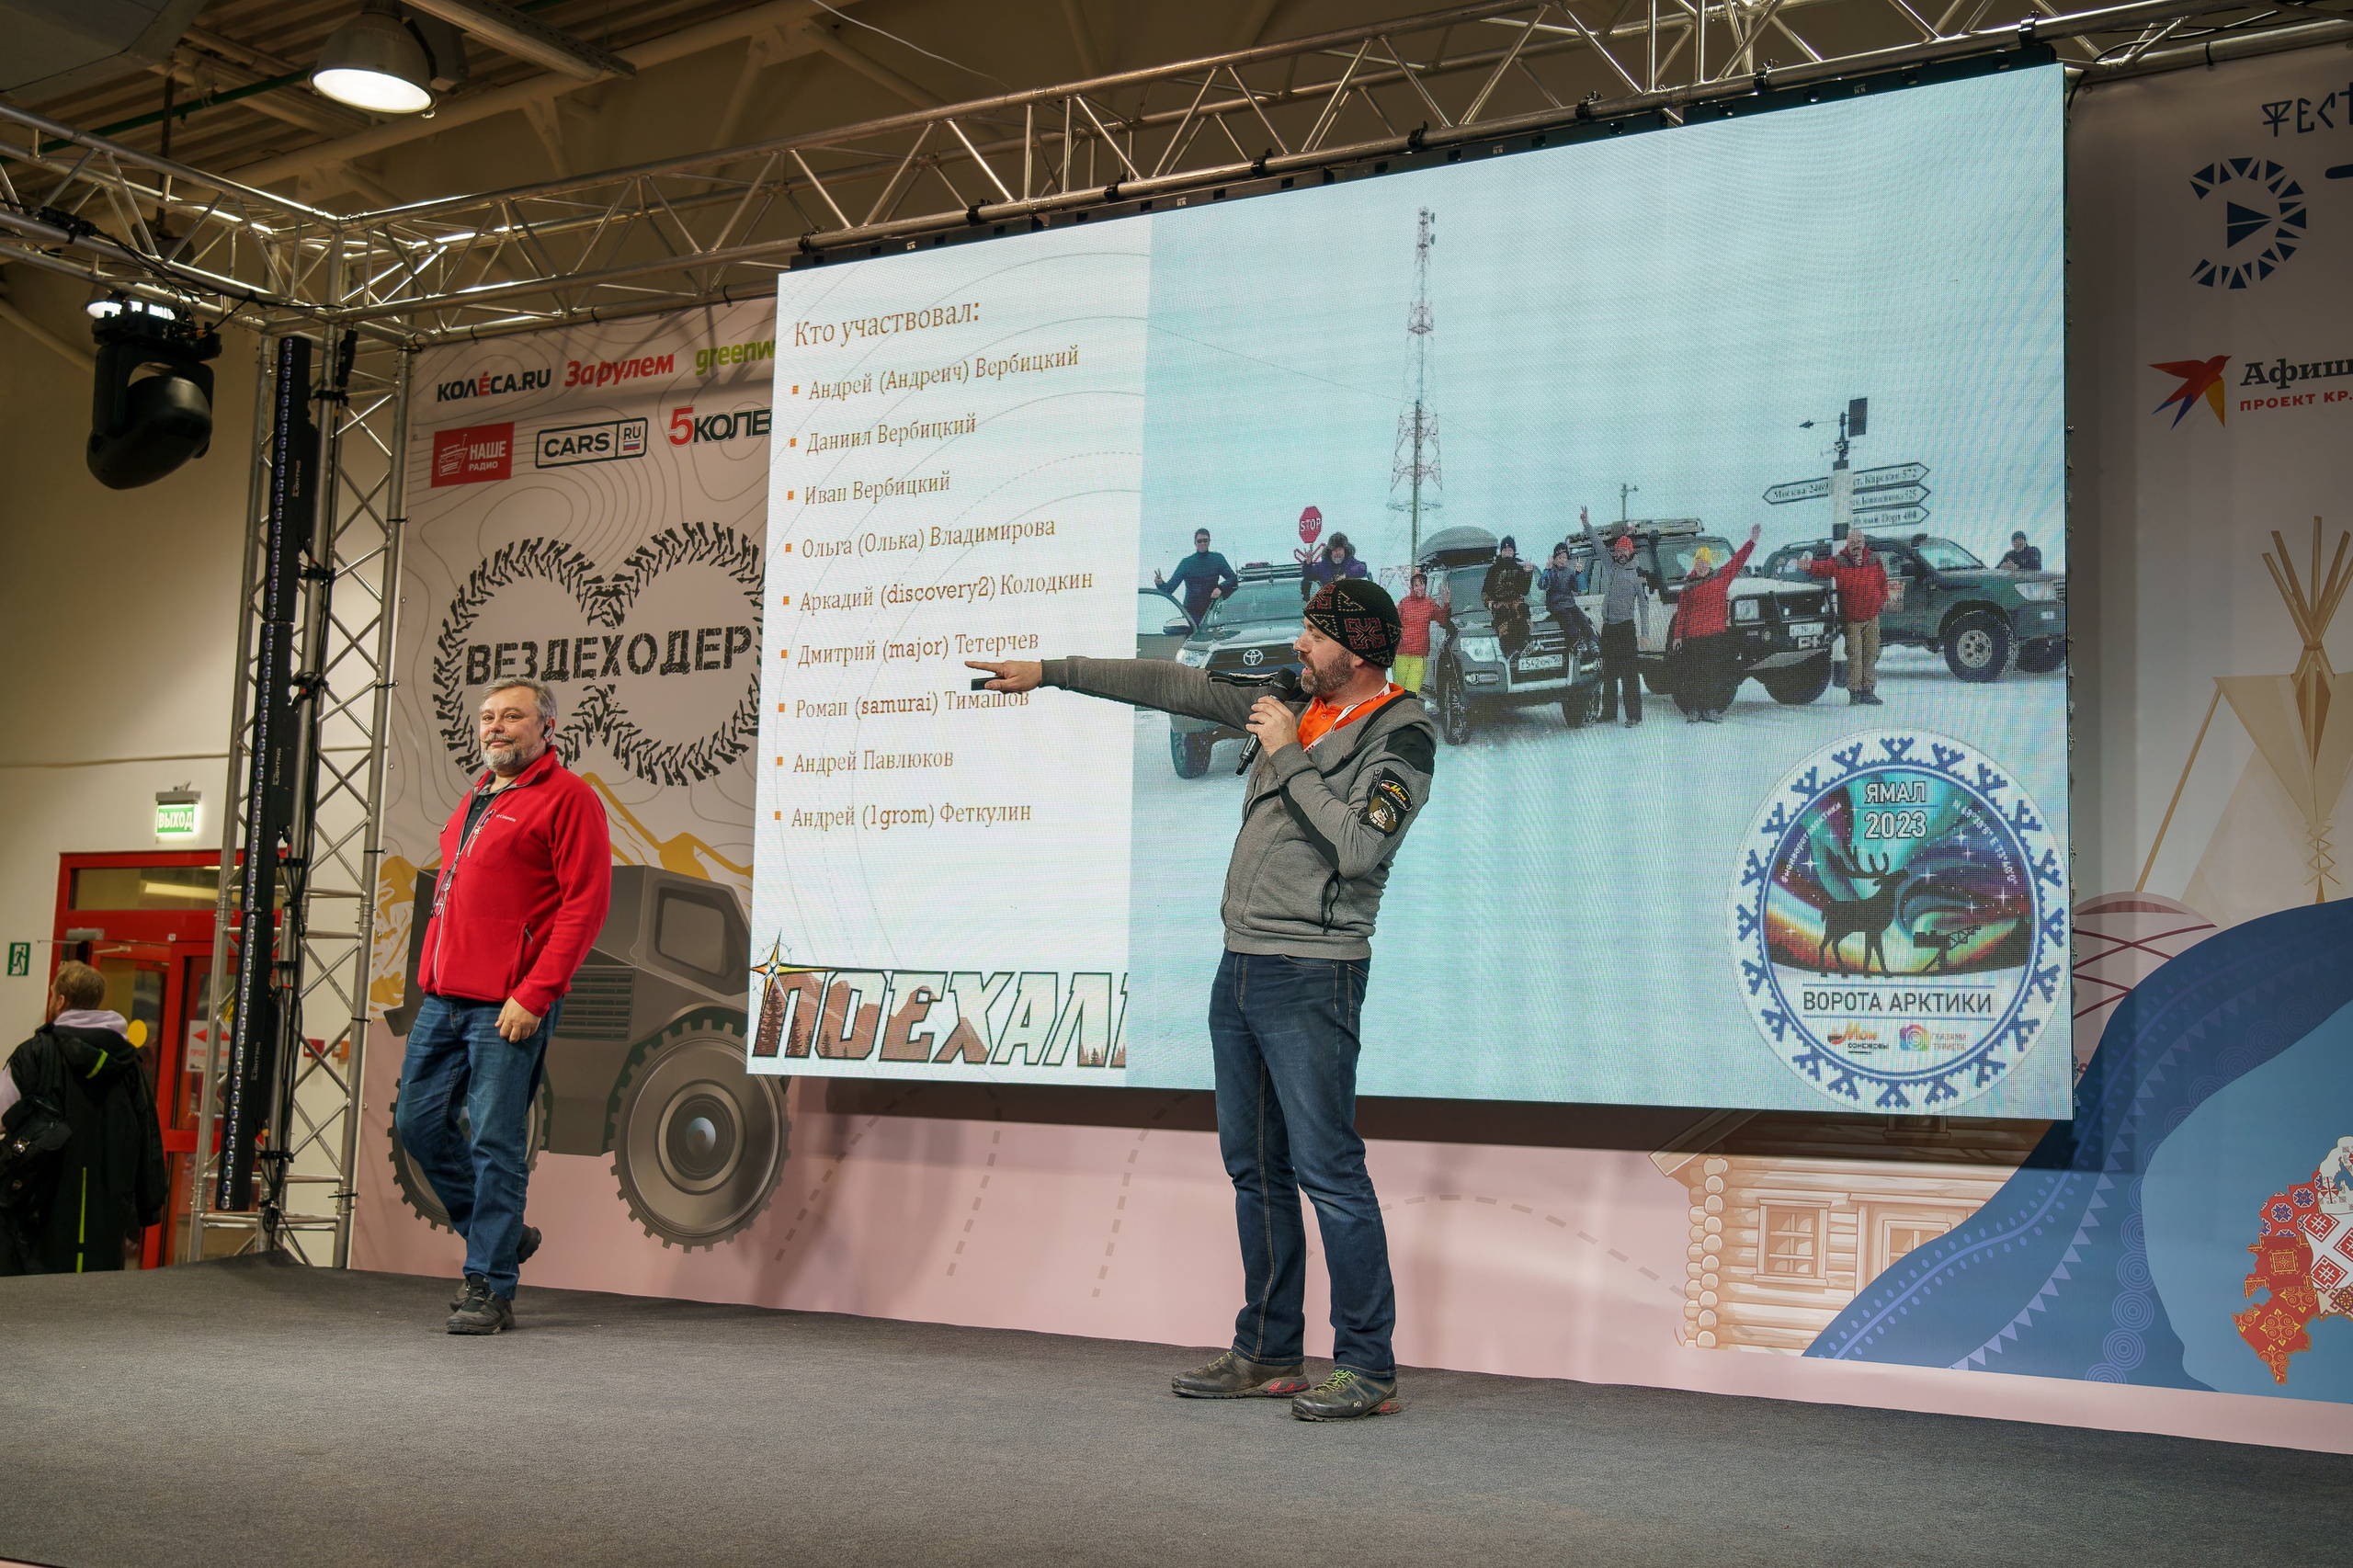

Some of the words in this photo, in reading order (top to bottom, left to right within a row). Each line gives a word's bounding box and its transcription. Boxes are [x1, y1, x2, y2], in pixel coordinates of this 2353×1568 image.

[794, 321, 835, 347] Кто
[841, 302, 980, 347] участвовал:
[808, 372, 872, 401] Андрей
[880, 359, 969, 395] (Андреич)
[976, 345, 1079, 380] Вербицкий
[2240, 358, 2353, 390] Афиш
[2240, 393, 2316, 412] ПРОЕКТ
[2324, 390, 2353, 403] КР.
[668, 406, 772, 446] 5КОЛЕ
[806, 429, 871, 456] Даниил
[878, 414, 977, 448] Вербицкий
[470, 439, 506, 458] НАШЕ
[544, 432, 610, 458] CARS
[623, 426, 642, 440] RU
[469, 460, 498, 472] РАДИО
[804, 485, 847, 506] Иван
[853, 471, 950, 504] Вербицкий
[802, 539, 852, 559] Ольга
[858, 528, 925, 557] (Олька)
[930, 520, 1055, 549] Владимирова
[1300, 517, 1321, 532] STOP
[800, 586, 873, 615] Аркадий
[881, 575, 996, 609] (discovery2)
[1001, 572, 1093, 596] Колодкин
[465, 625, 753, 686] ВЕЗДЕХОДЕР
[798, 641, 875, 668] Дмитрий
[882, 635, 949, 663] (major)
[955, 631, 1039, 658] Тетерчев
[796, 699, 847, 719] Роман
[855, 691, 938, 720] (samurai)
[945, 690, 1029, 710] Тимашов
[793, 751, 857, 777] Андрей
[864, 749, 953, 771] Павлюков
[1865, 781, 1927, 804] ЯМАЛ
[158, 810, 193, 832] ВЫХОД
[791, 805, 855, 831] Андрей
[940, 801, 1031, 826] Феткулин
[1864, 812, 1927, 840] 2023
[1803, 991, 1882, 1013] ВОРОТА
[1889, 992, 1992, 1014] АРКТИКИ
